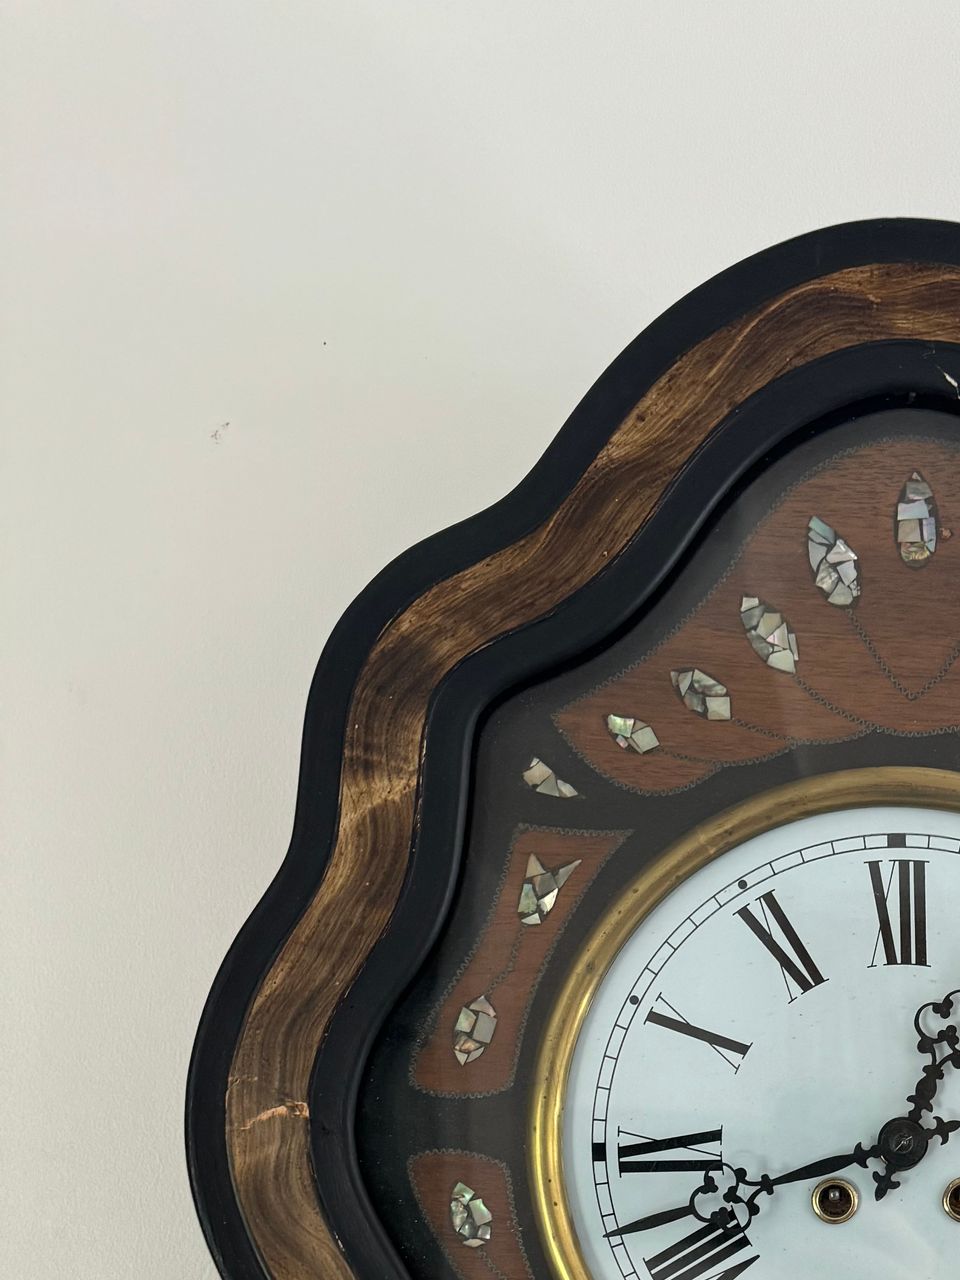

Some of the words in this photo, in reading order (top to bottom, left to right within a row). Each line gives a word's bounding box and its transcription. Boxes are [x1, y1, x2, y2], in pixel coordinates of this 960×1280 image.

[732, 889, 829, 1004] XI
[864, 859, 931, 968] XII
[643, 992, 753, 1075] X
[617, 1124, 725, 1179] IX
